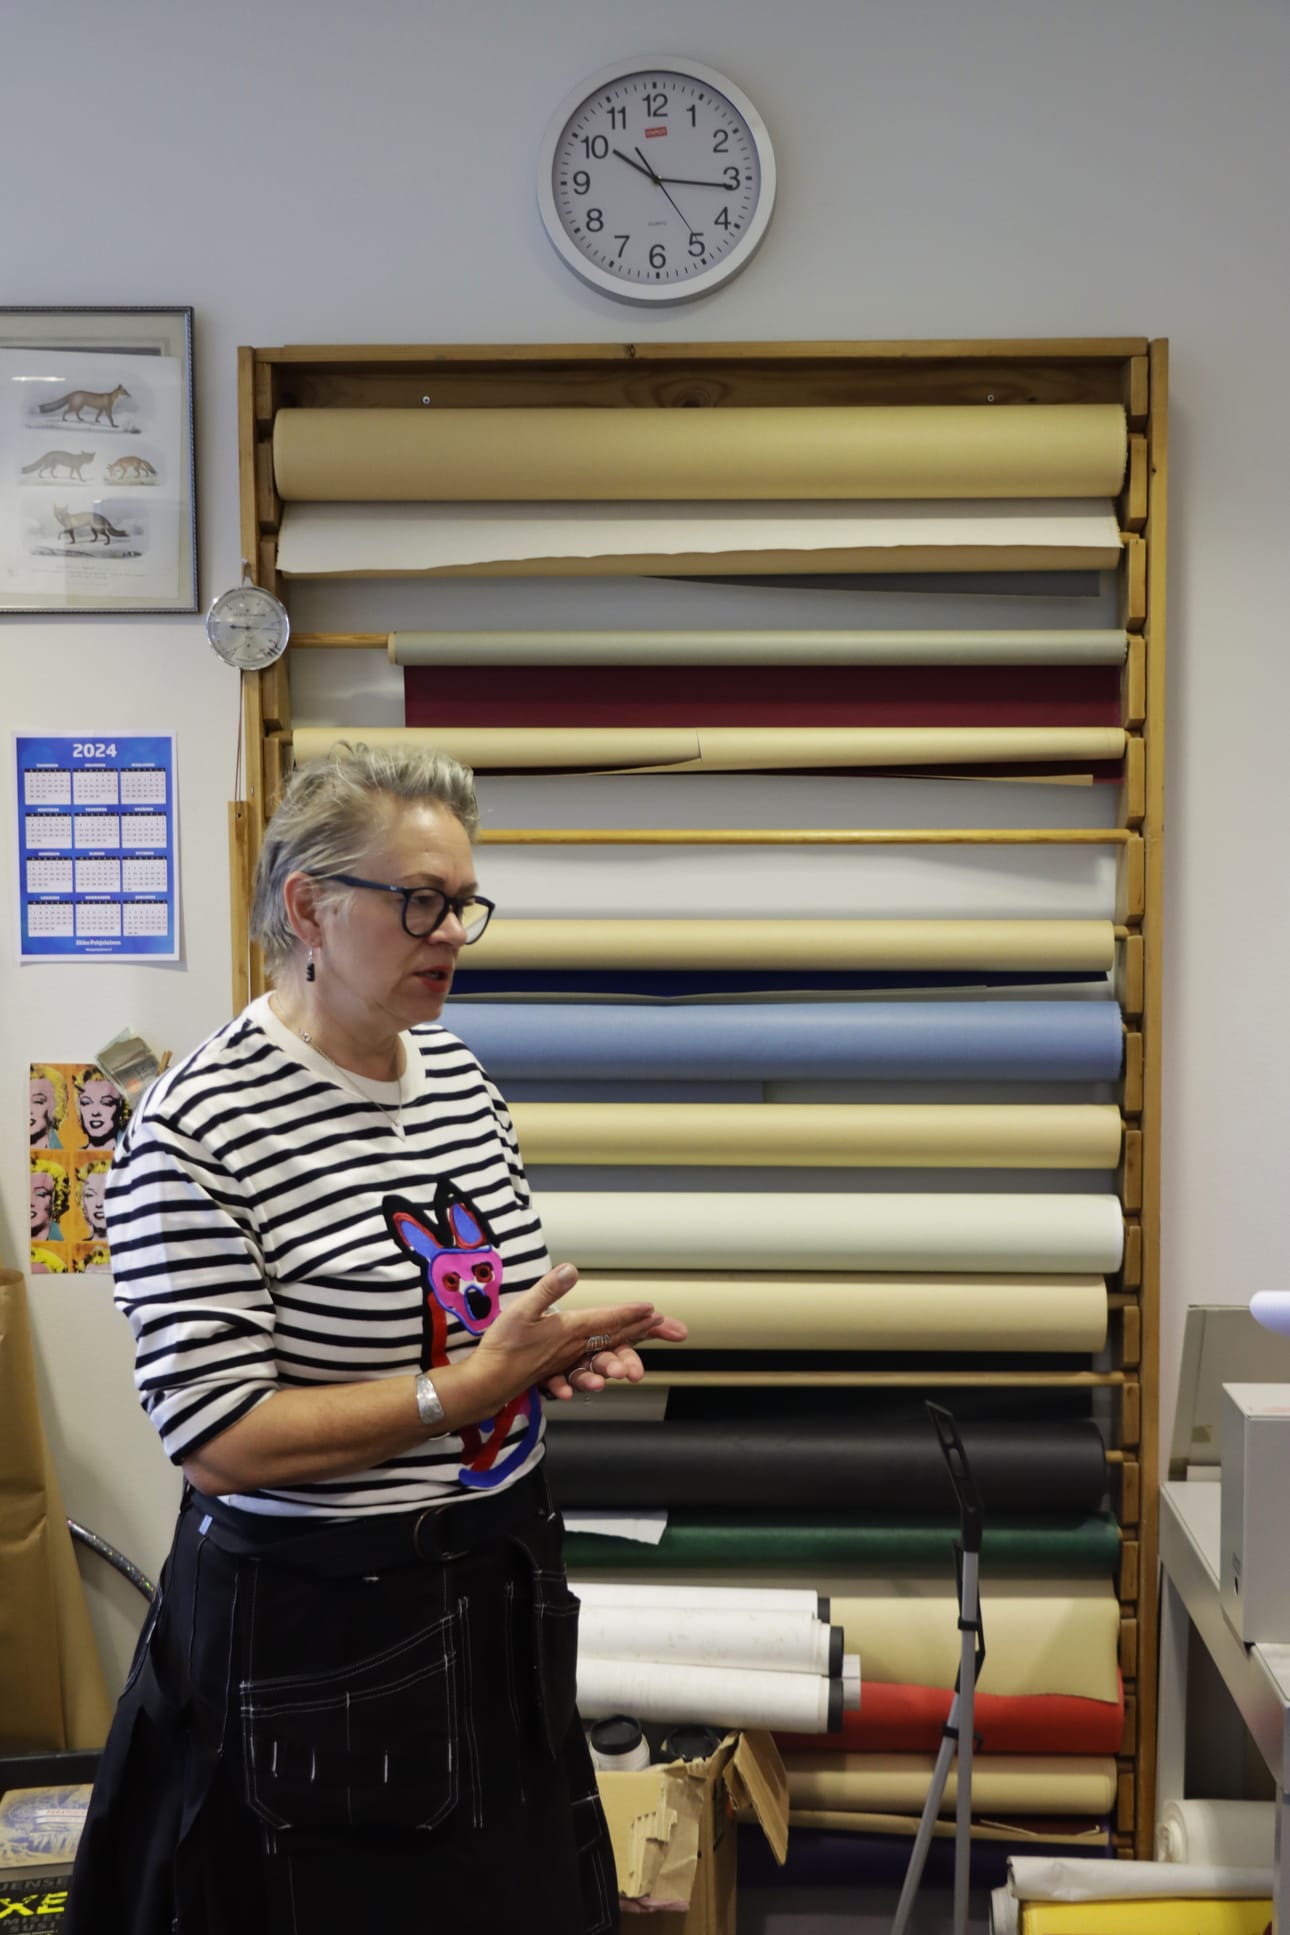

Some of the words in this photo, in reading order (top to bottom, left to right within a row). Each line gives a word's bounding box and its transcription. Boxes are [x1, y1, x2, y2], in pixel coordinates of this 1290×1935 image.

[643, 93, 667, 117] 12
[687, 105, 695, 127] 1
[607, 106, 626, 130] 11
[581, 135, 608, 159] 10
[713, 129, 728, 153] 2
[573, 171, 590, 195] 9
[723, 167, 740, 191] 3
[586, 208, 603, 232] 8
[714, 207, 731, 230] 4
[615, 235, 630, 258] 7
[688, 231, 705, 256] 5
[649, 244, 666, 269] 6
[72, 743, 118, 758] 2024
